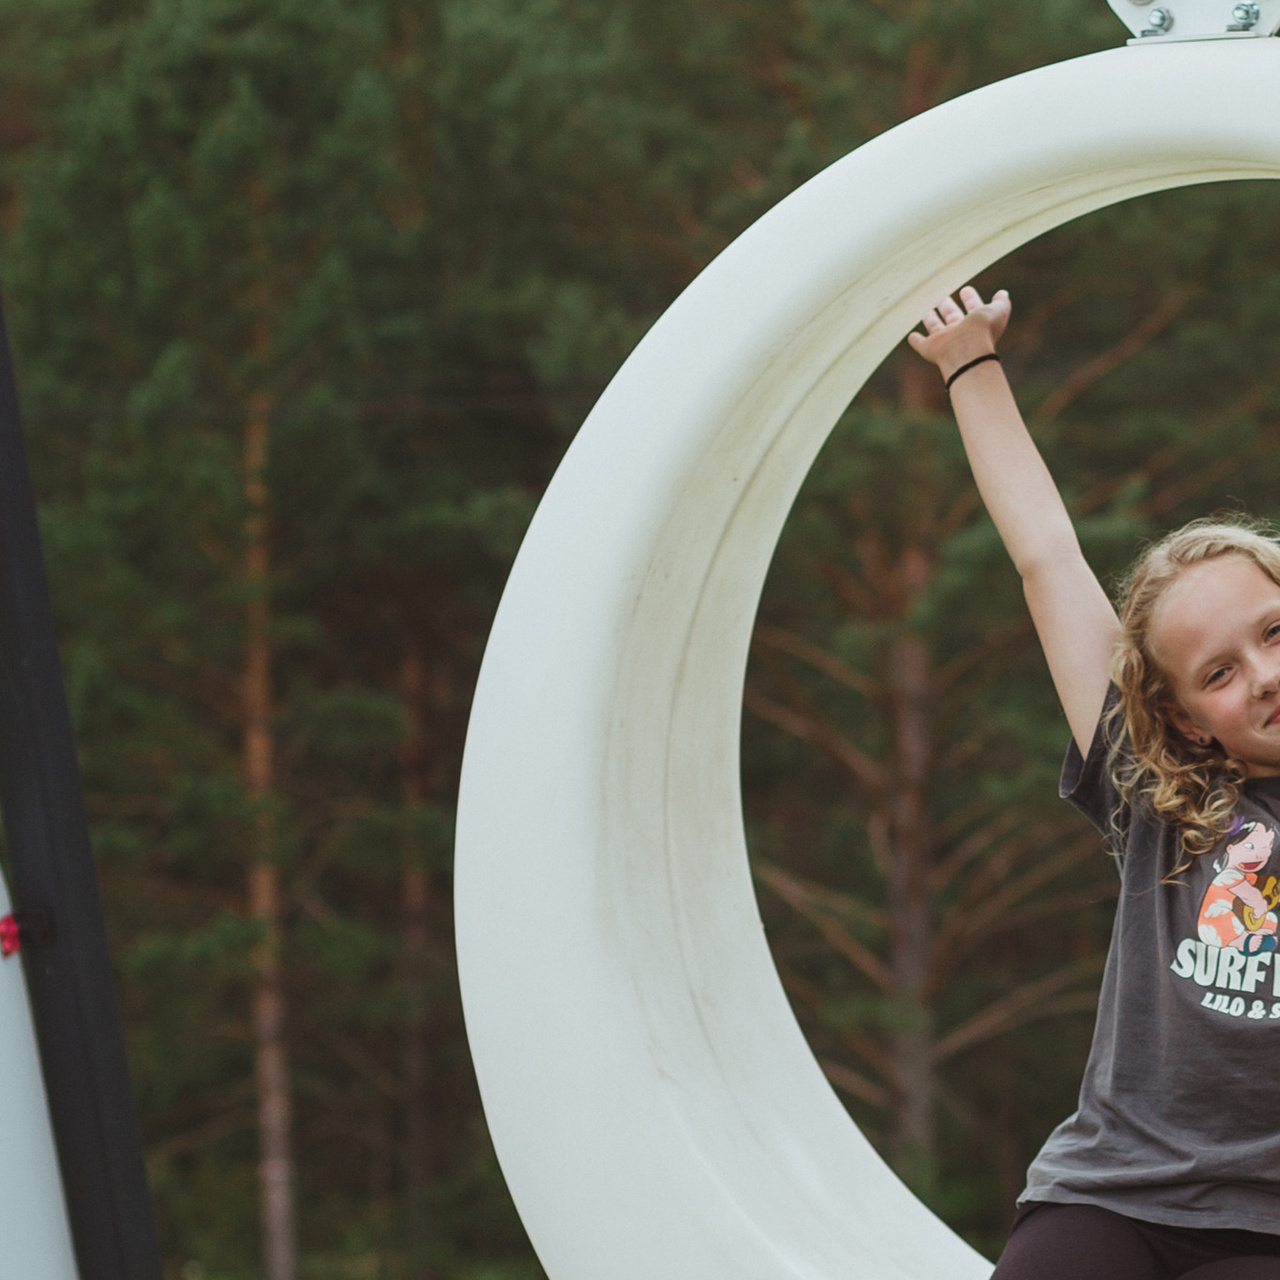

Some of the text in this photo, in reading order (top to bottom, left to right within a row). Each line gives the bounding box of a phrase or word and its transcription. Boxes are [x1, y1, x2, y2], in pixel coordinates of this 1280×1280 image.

[1170, 938, 1272, 993] SURF
[1201, 991, 1246, 1017] LILO
[1247, 999, 1267, 1020] &
